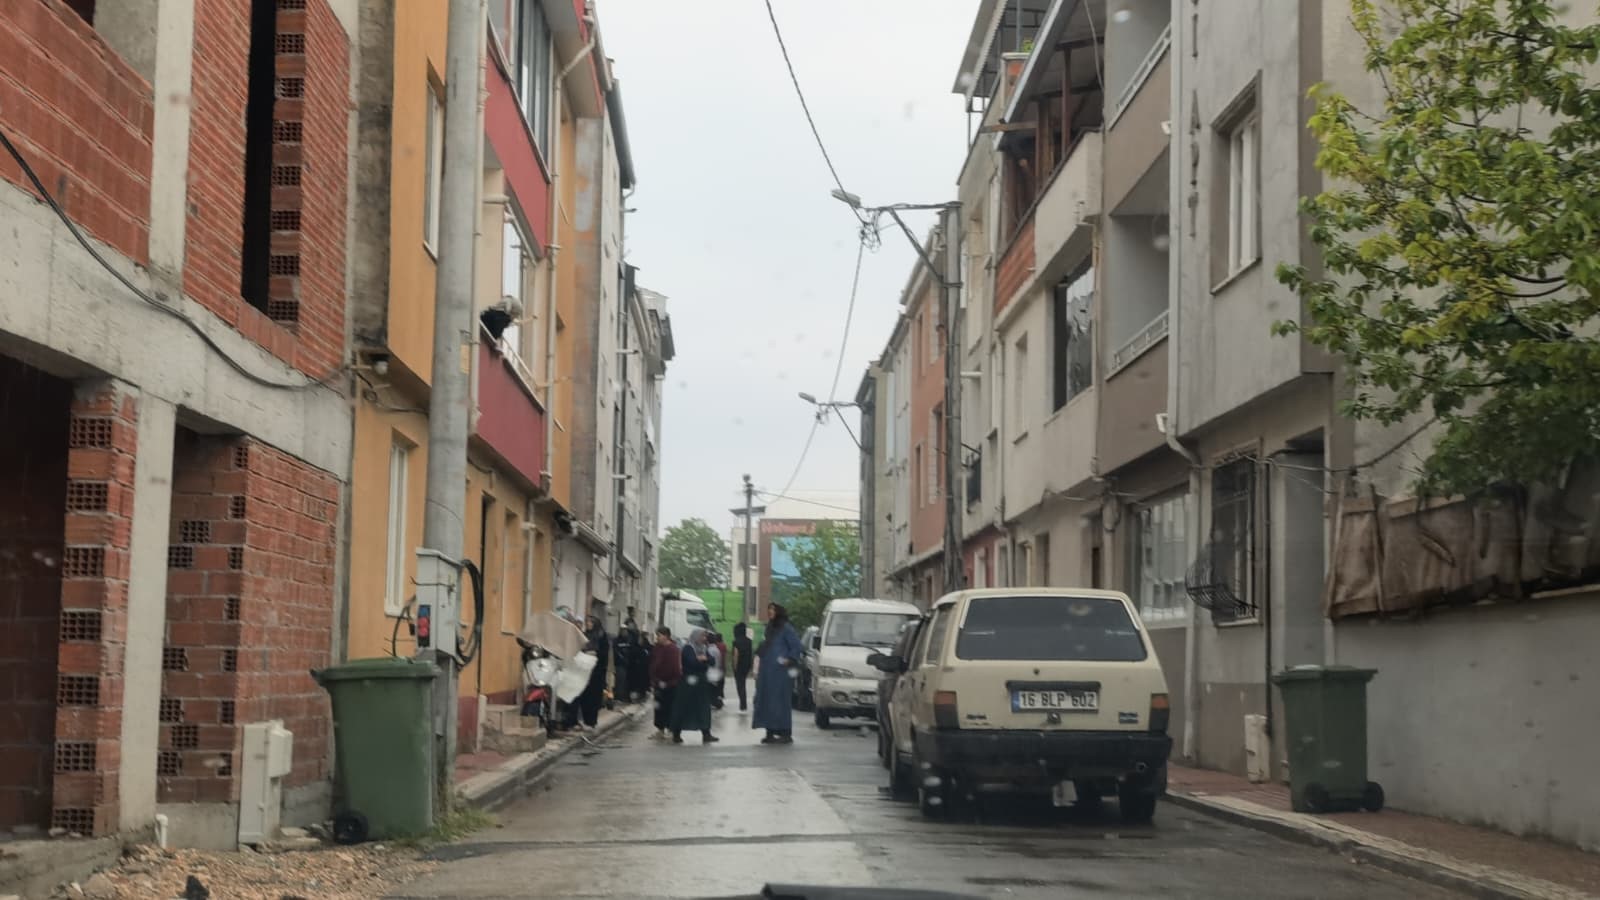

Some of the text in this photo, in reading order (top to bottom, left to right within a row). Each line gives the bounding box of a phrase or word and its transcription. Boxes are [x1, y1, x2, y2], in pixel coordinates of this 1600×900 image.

[1021, 692, 1095, 708] 16 BLP 602
